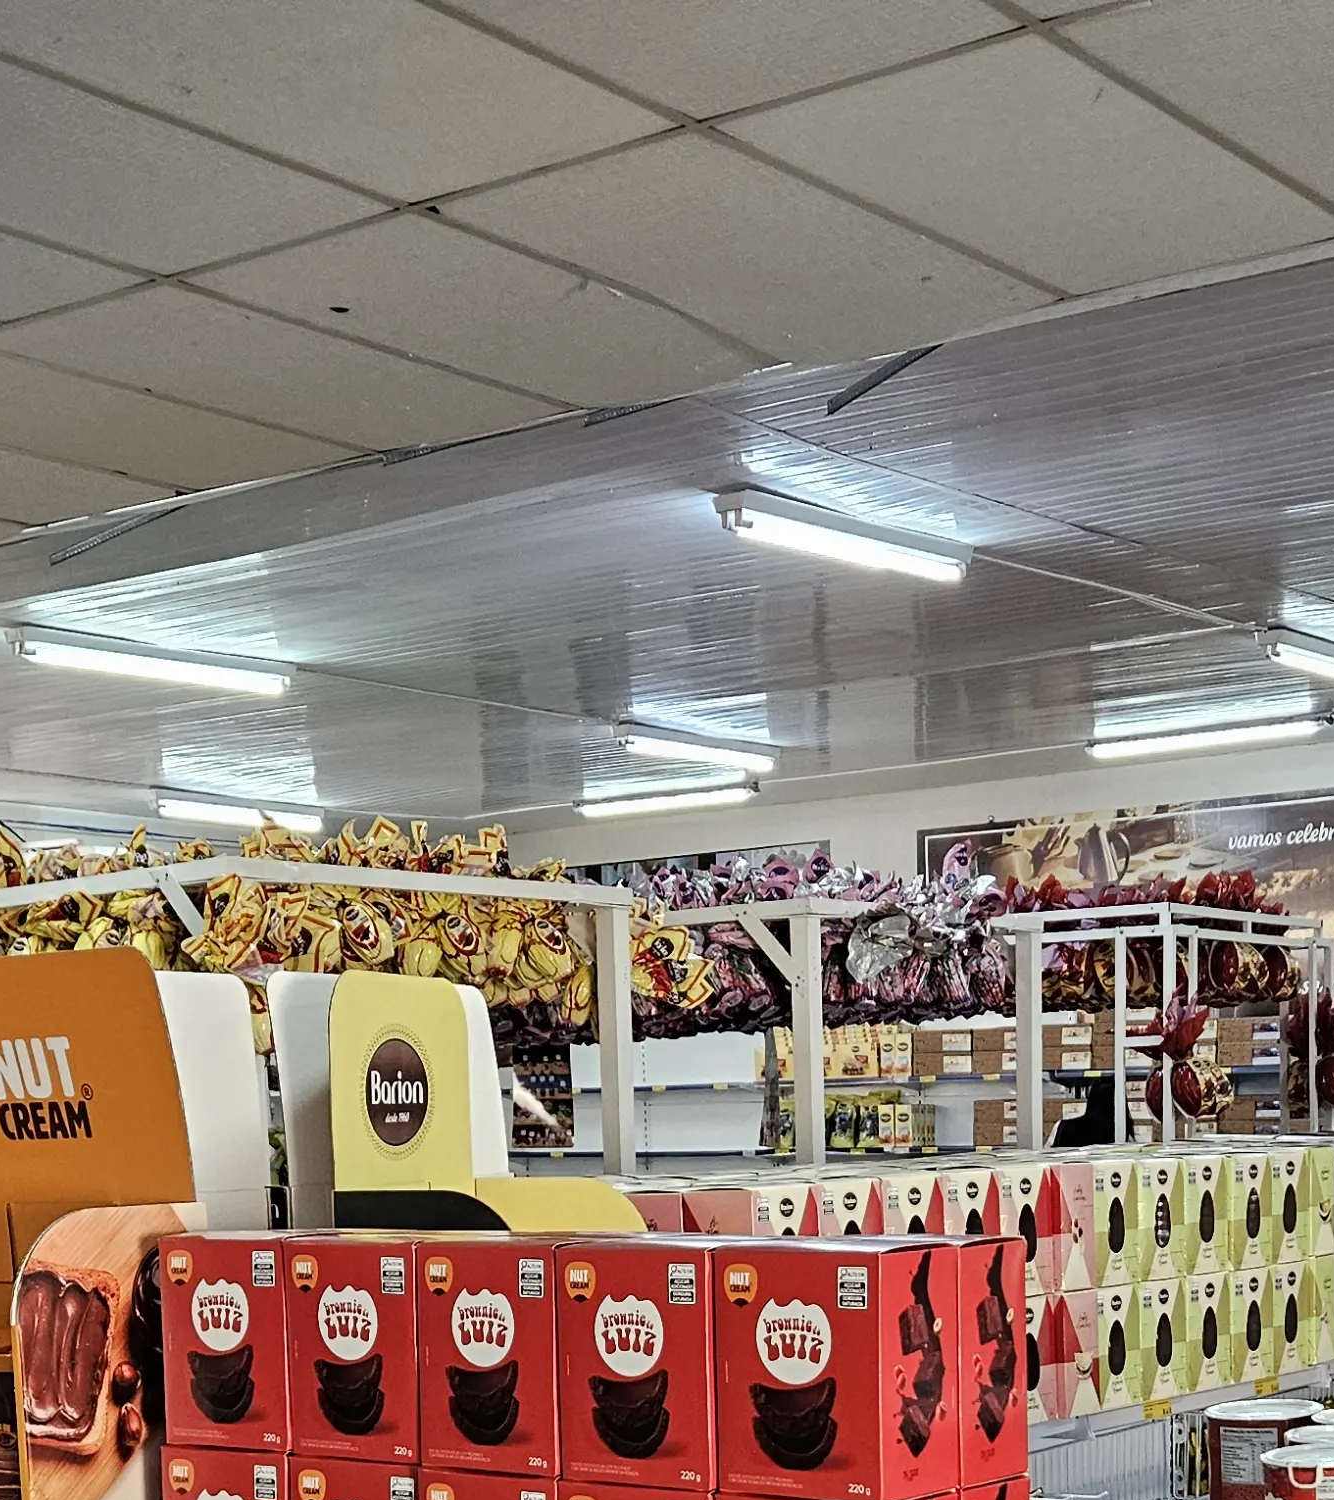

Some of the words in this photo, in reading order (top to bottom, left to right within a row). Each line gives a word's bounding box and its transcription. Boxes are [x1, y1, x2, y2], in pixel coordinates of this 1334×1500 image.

[1229, 829, 1282, 850] vamos
[370, 1070, 424, 1105] Barion
[729, 1272, 749, 1285] NUT
[730, 1284, 750, 1293] CREAM
[198, 1294, 235, 1309] brownie
[322, 1299, 362, 1317] brownie
[197, 1307, 244, 1333] LUIZ
[457, 1302, 499, 1322] brownie
[600, 1309, 646, 1329] brownie
[323, 1315, 372, 1343] LUIZ
[457, 1319, 509, 1348] LUIZ
[762, 1314, 812, 1334] brownie
[601, 1327, 657, 1357] LUIZ
[763, 1333, 825, 1365] LUIZ
[848, 1483, 864, 1494] 220
